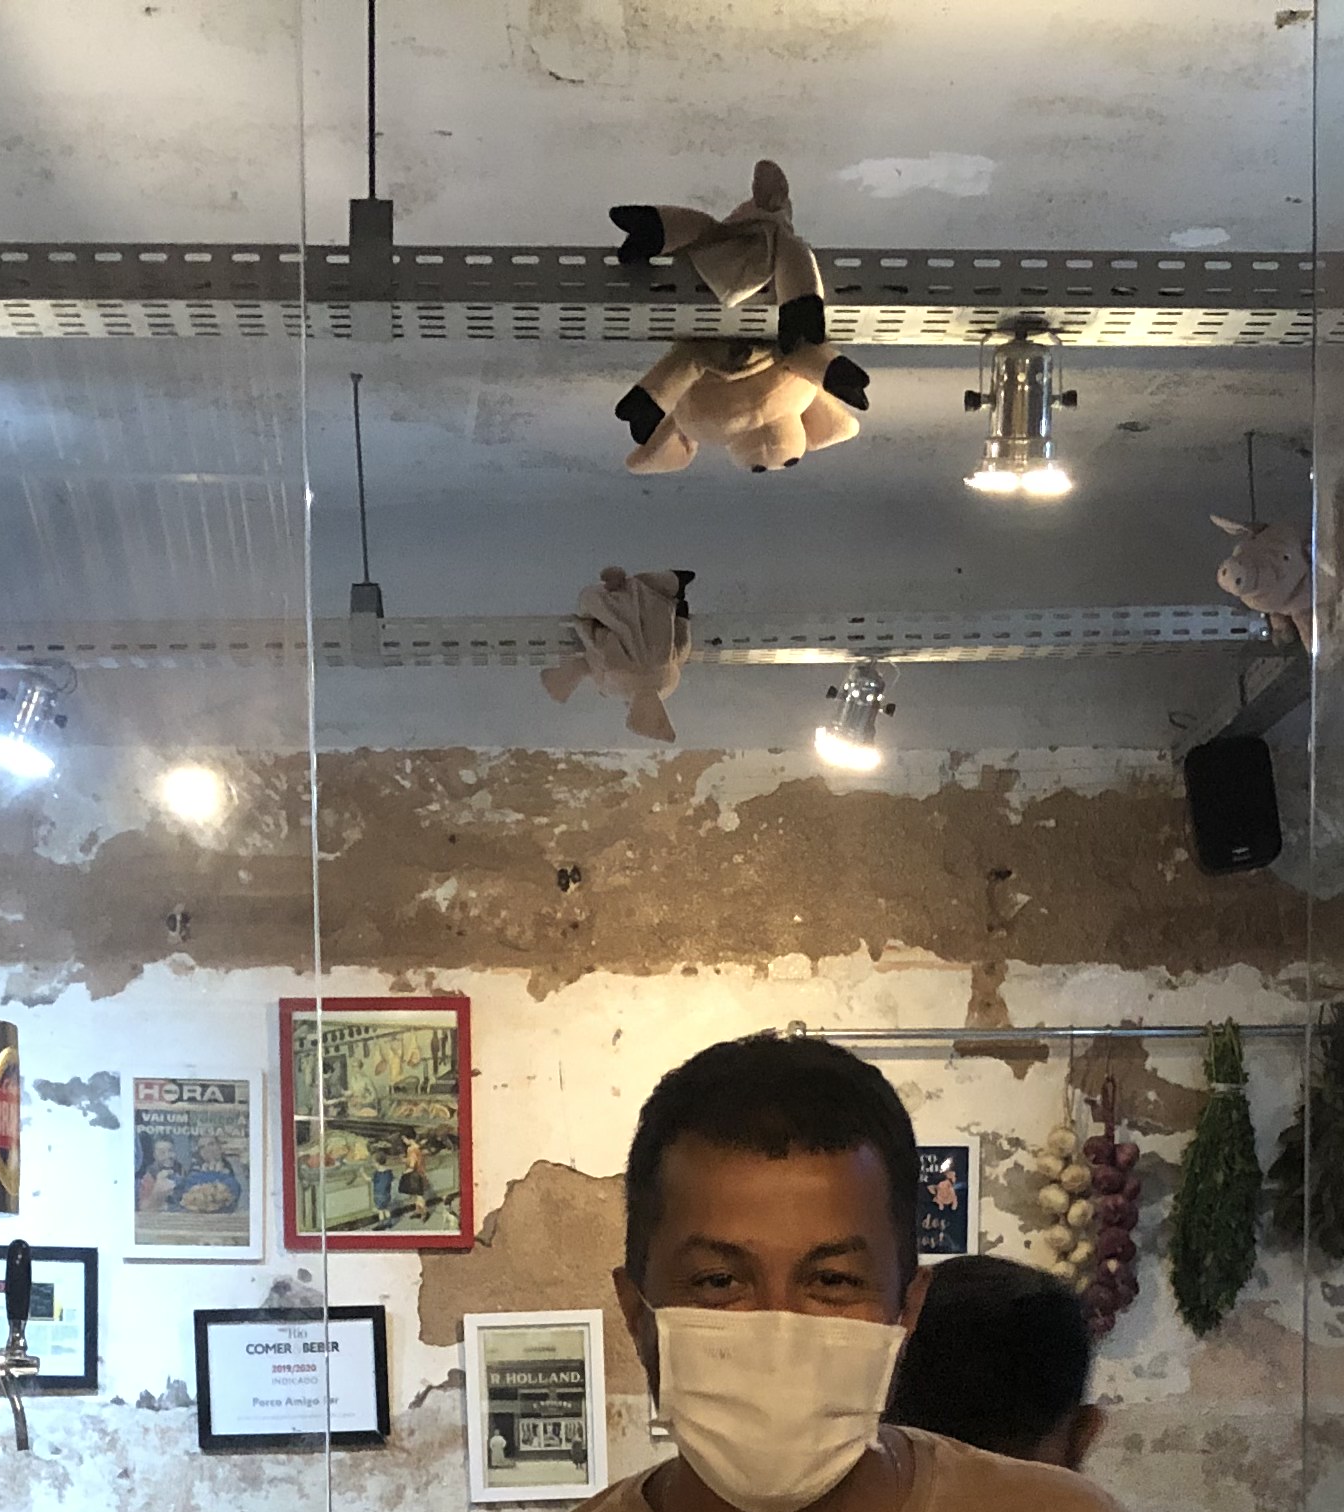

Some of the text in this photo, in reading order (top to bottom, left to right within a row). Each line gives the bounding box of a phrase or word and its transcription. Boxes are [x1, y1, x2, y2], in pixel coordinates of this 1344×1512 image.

[138, 1083, 224, 1102] HORA
[167, 1112, 189, 1122] UM
[246, 1343, 292, 1355] COMER
[272, 1364, 317, 1374] 2019/2020
[272, 1376, 319, 1386] INDICADO
[252, 1397, 282, 1407] Porco
[285, 1396, 320, 1408] Amigo
